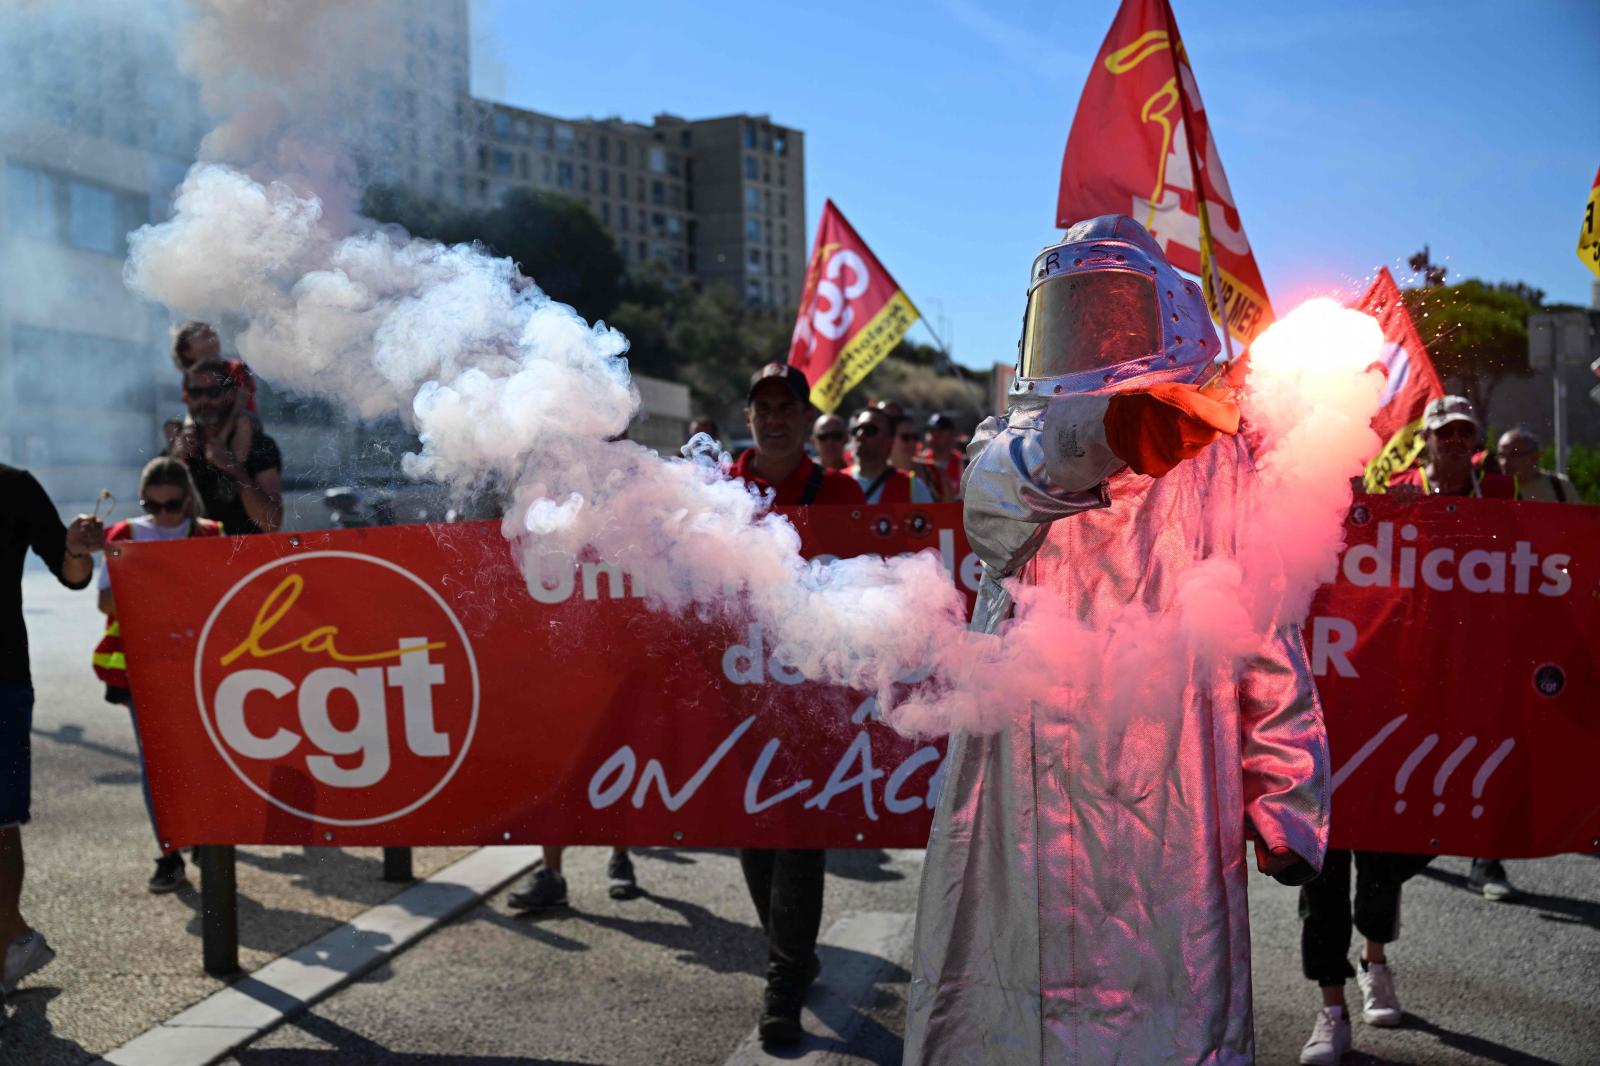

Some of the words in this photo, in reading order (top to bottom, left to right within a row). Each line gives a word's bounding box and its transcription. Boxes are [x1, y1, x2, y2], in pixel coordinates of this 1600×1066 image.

[1324, 521, 1573, 598] dicats
[220, 573, 447, 667] la
[214, 636, 451, 789] cgt
[587, 714, 757, 812] ON
